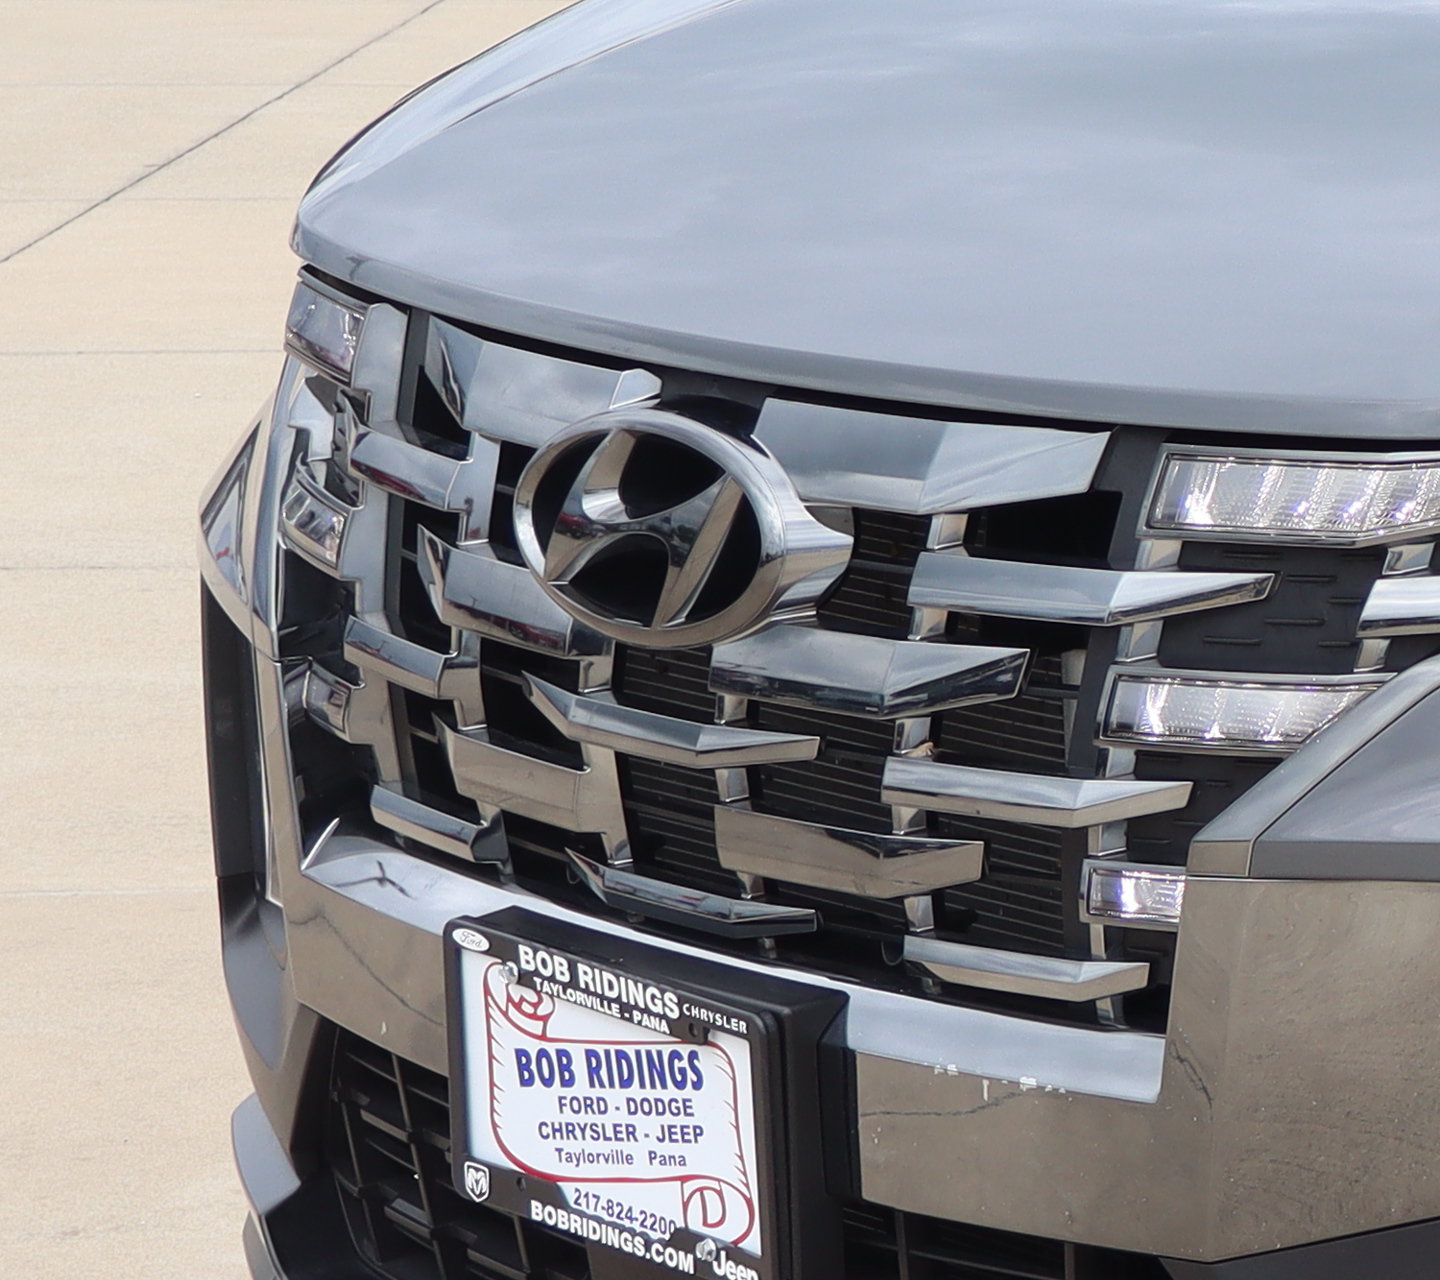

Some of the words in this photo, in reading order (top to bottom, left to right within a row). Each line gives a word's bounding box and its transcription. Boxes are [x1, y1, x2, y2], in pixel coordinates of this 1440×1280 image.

[518, 944, 571, 982] BOB
[577, 962, 680, 1019] RIDINGS
[533, 976, 621, 1018] TAYLORVILLE
[632, 1010, 670, 1034] PANA
[682, 1003, 747, 1034] CHRYSLER
[514, 1047, 576, 1088] BOB
[584, 1048, 705, 1091] RIDINGS
[557, 1096, 609, 1115] FORD
[626, 1097, 695, 1117] DODGE
[538, 1121, 639, 1142] CHRYSLER
[656, 1124, 704, 1144] JEEP
[554, 1147, 634, 1168] Taylorville
[648, 1150, 687, 1167] Pana
[573, 1187, 677, 1237] 217-824-2200
[530, 1199, 695, 1275] BOBRIDINGS.COM
